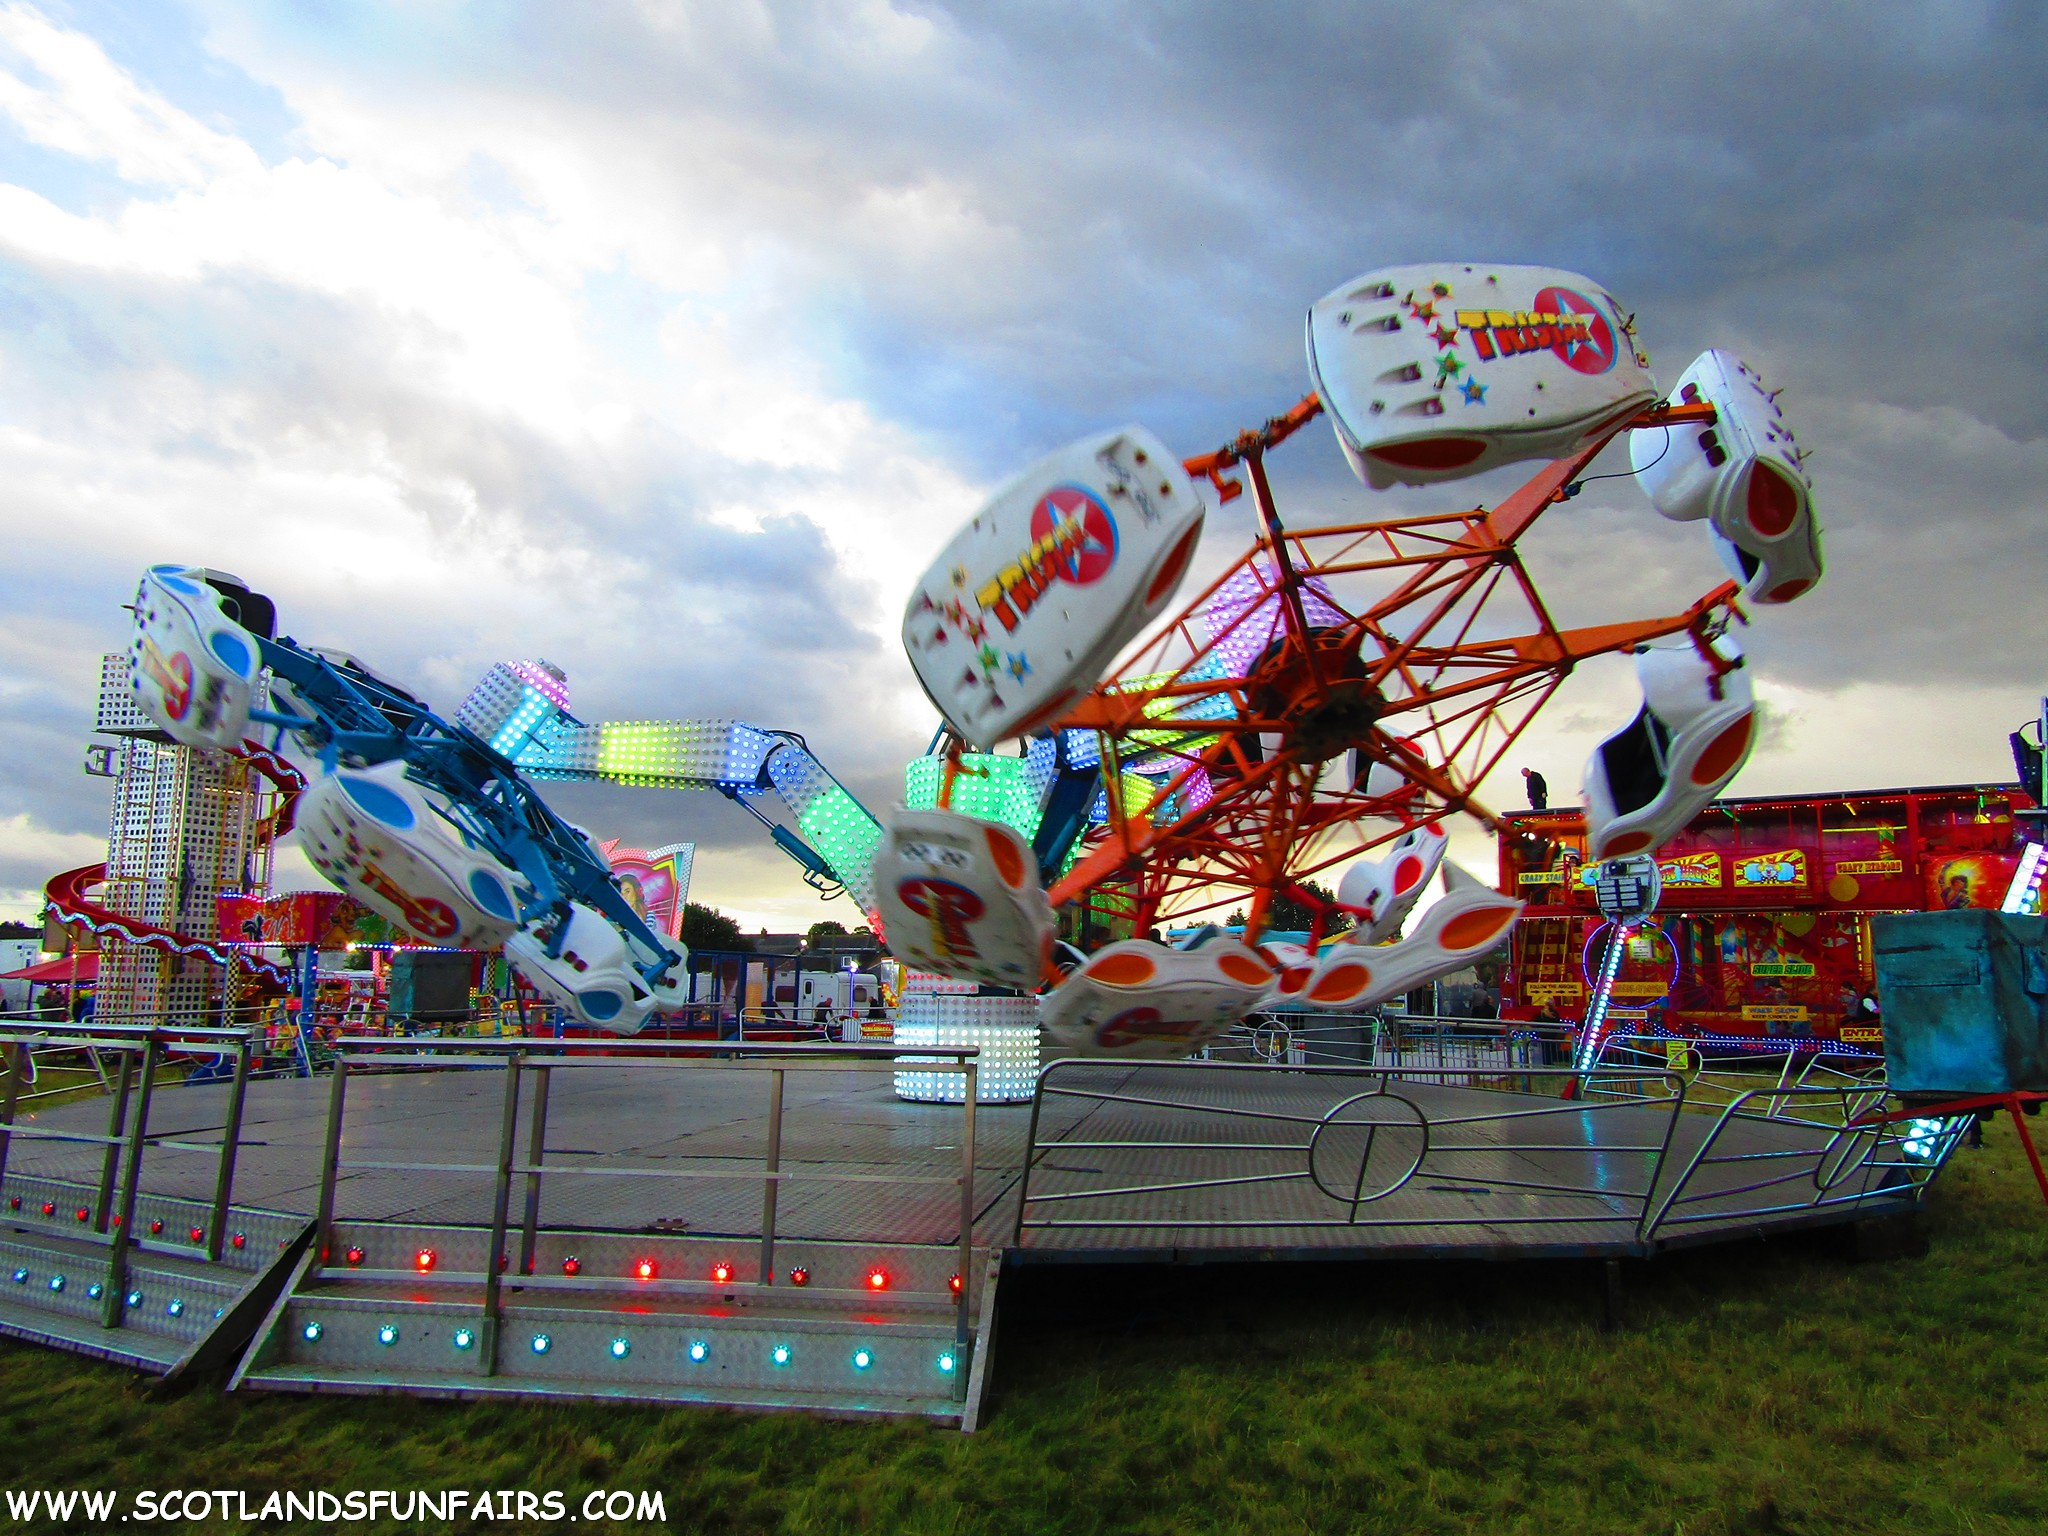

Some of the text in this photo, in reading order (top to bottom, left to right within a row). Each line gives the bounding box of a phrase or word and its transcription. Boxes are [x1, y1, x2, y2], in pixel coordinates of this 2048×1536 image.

[1520, 873, 1544, 883] CRAZY
[1752, 964, 1813, 975] SUPER SLIDE
